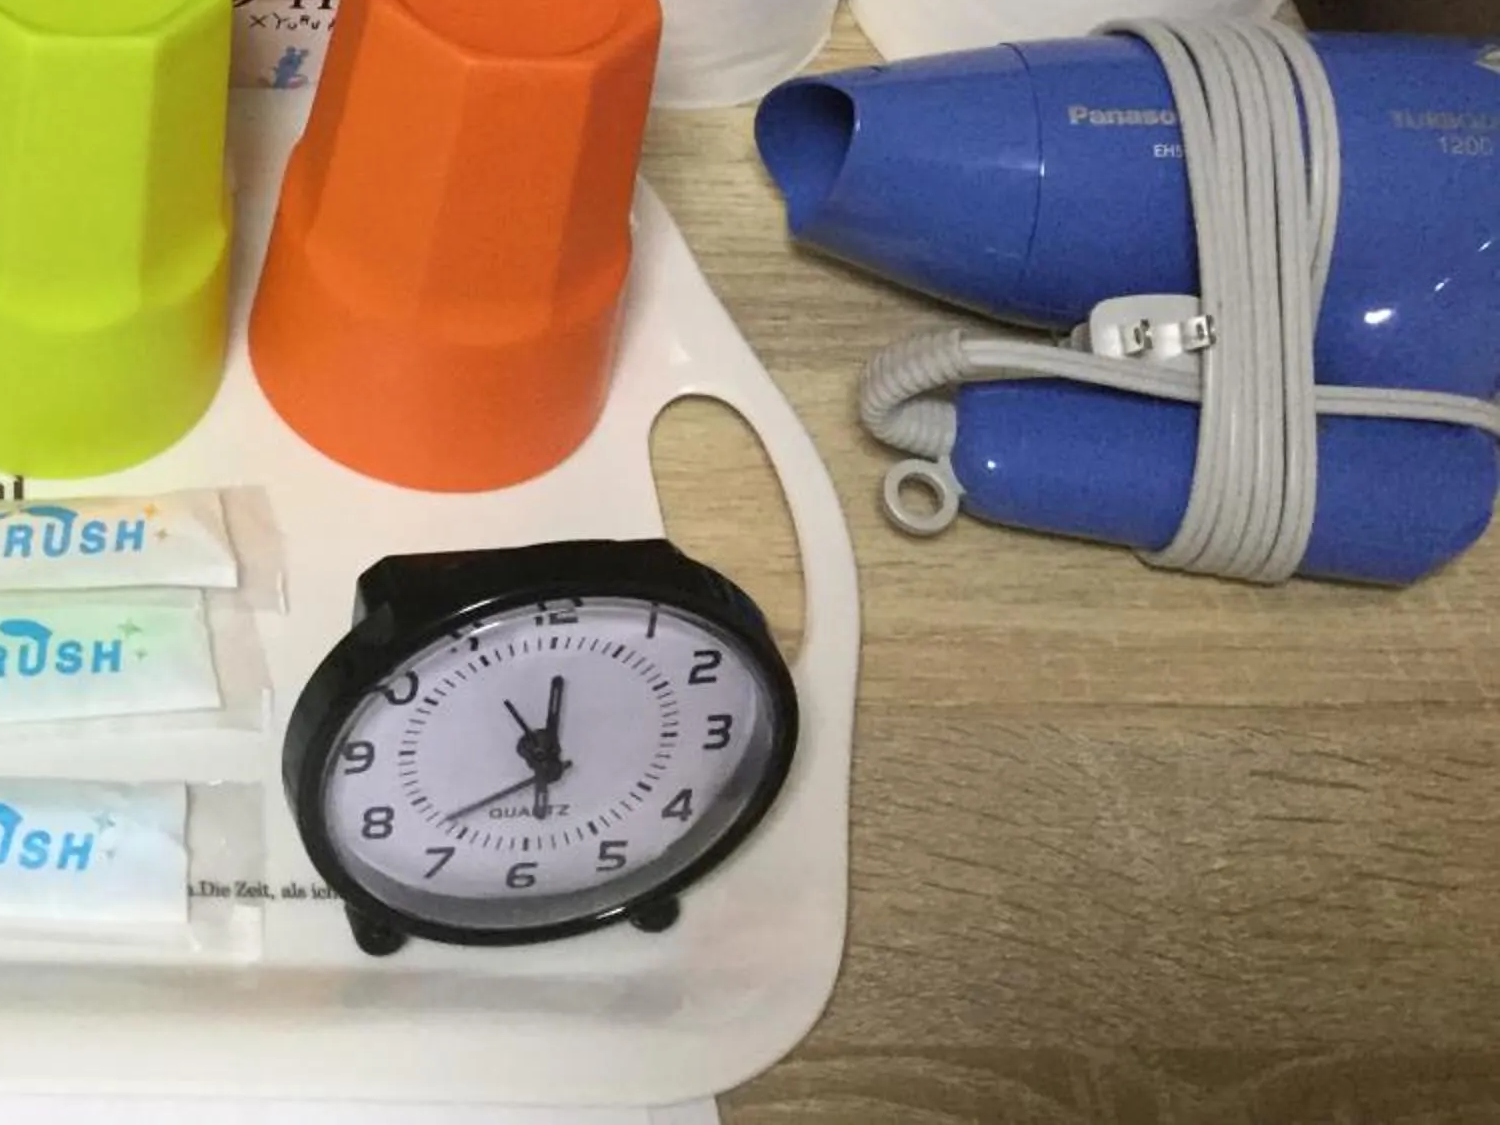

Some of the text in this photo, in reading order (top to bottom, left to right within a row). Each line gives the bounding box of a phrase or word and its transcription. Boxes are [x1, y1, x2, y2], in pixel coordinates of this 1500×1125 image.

[1068, 104, 1177, 126] Panaso
[687, 649, 723, 686] 2
[702, 713, 734, 751] 3
[343, 741, 377, 775] 9
[489, 803, 571, 819] QUATZ
[661, 787, 695, 823] 4
[361, 806, 396, 841] 8
[424, 846, 456, 879] 7
[595, 839, 630, 873] 5
[280, 882, 308, 899] als
[506, 862, 540, 890] 6
